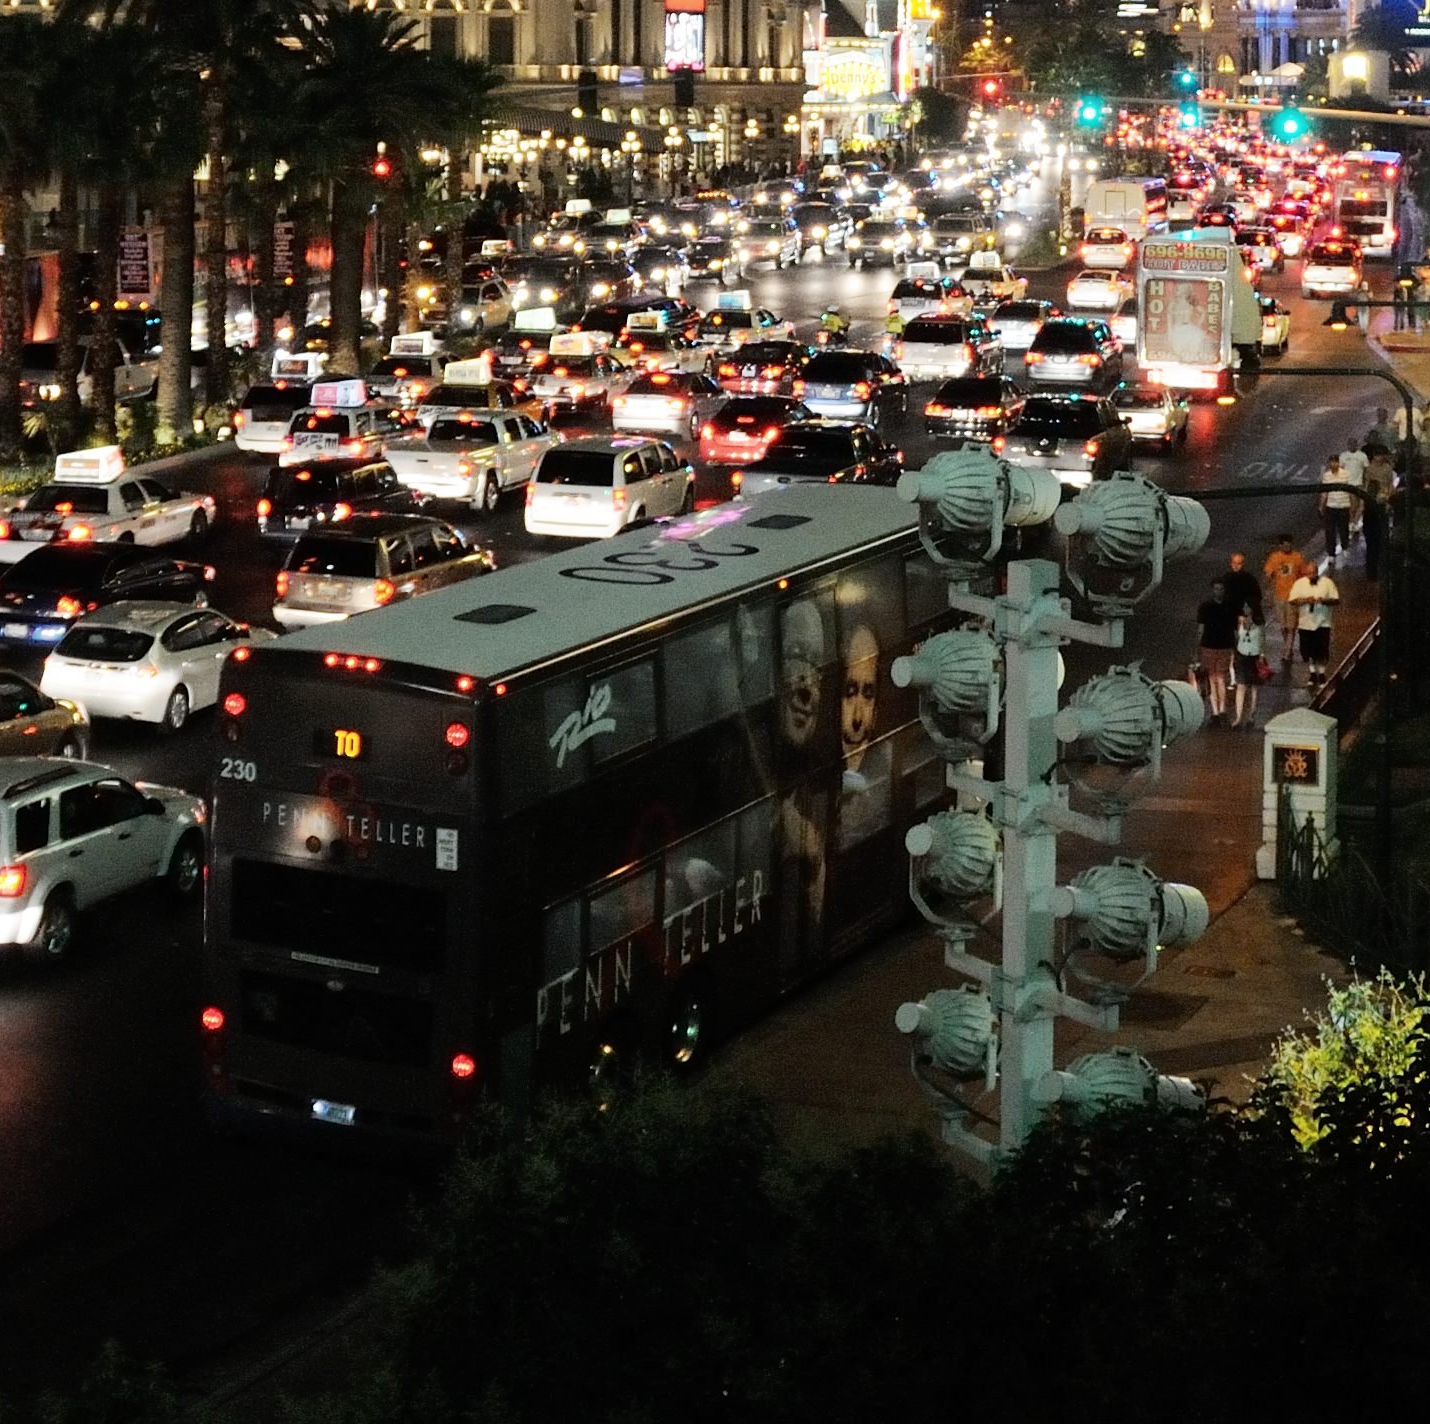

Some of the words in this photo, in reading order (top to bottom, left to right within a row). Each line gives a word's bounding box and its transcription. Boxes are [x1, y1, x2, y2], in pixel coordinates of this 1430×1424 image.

[1145, 245, 1226, 260] 696-9696
[1148, 281, 1165, 332] HOT
[334, 729, 362, 758] TO
[220, 757, 257, 783] 230
[346, 814, 426, 849] TELLER
